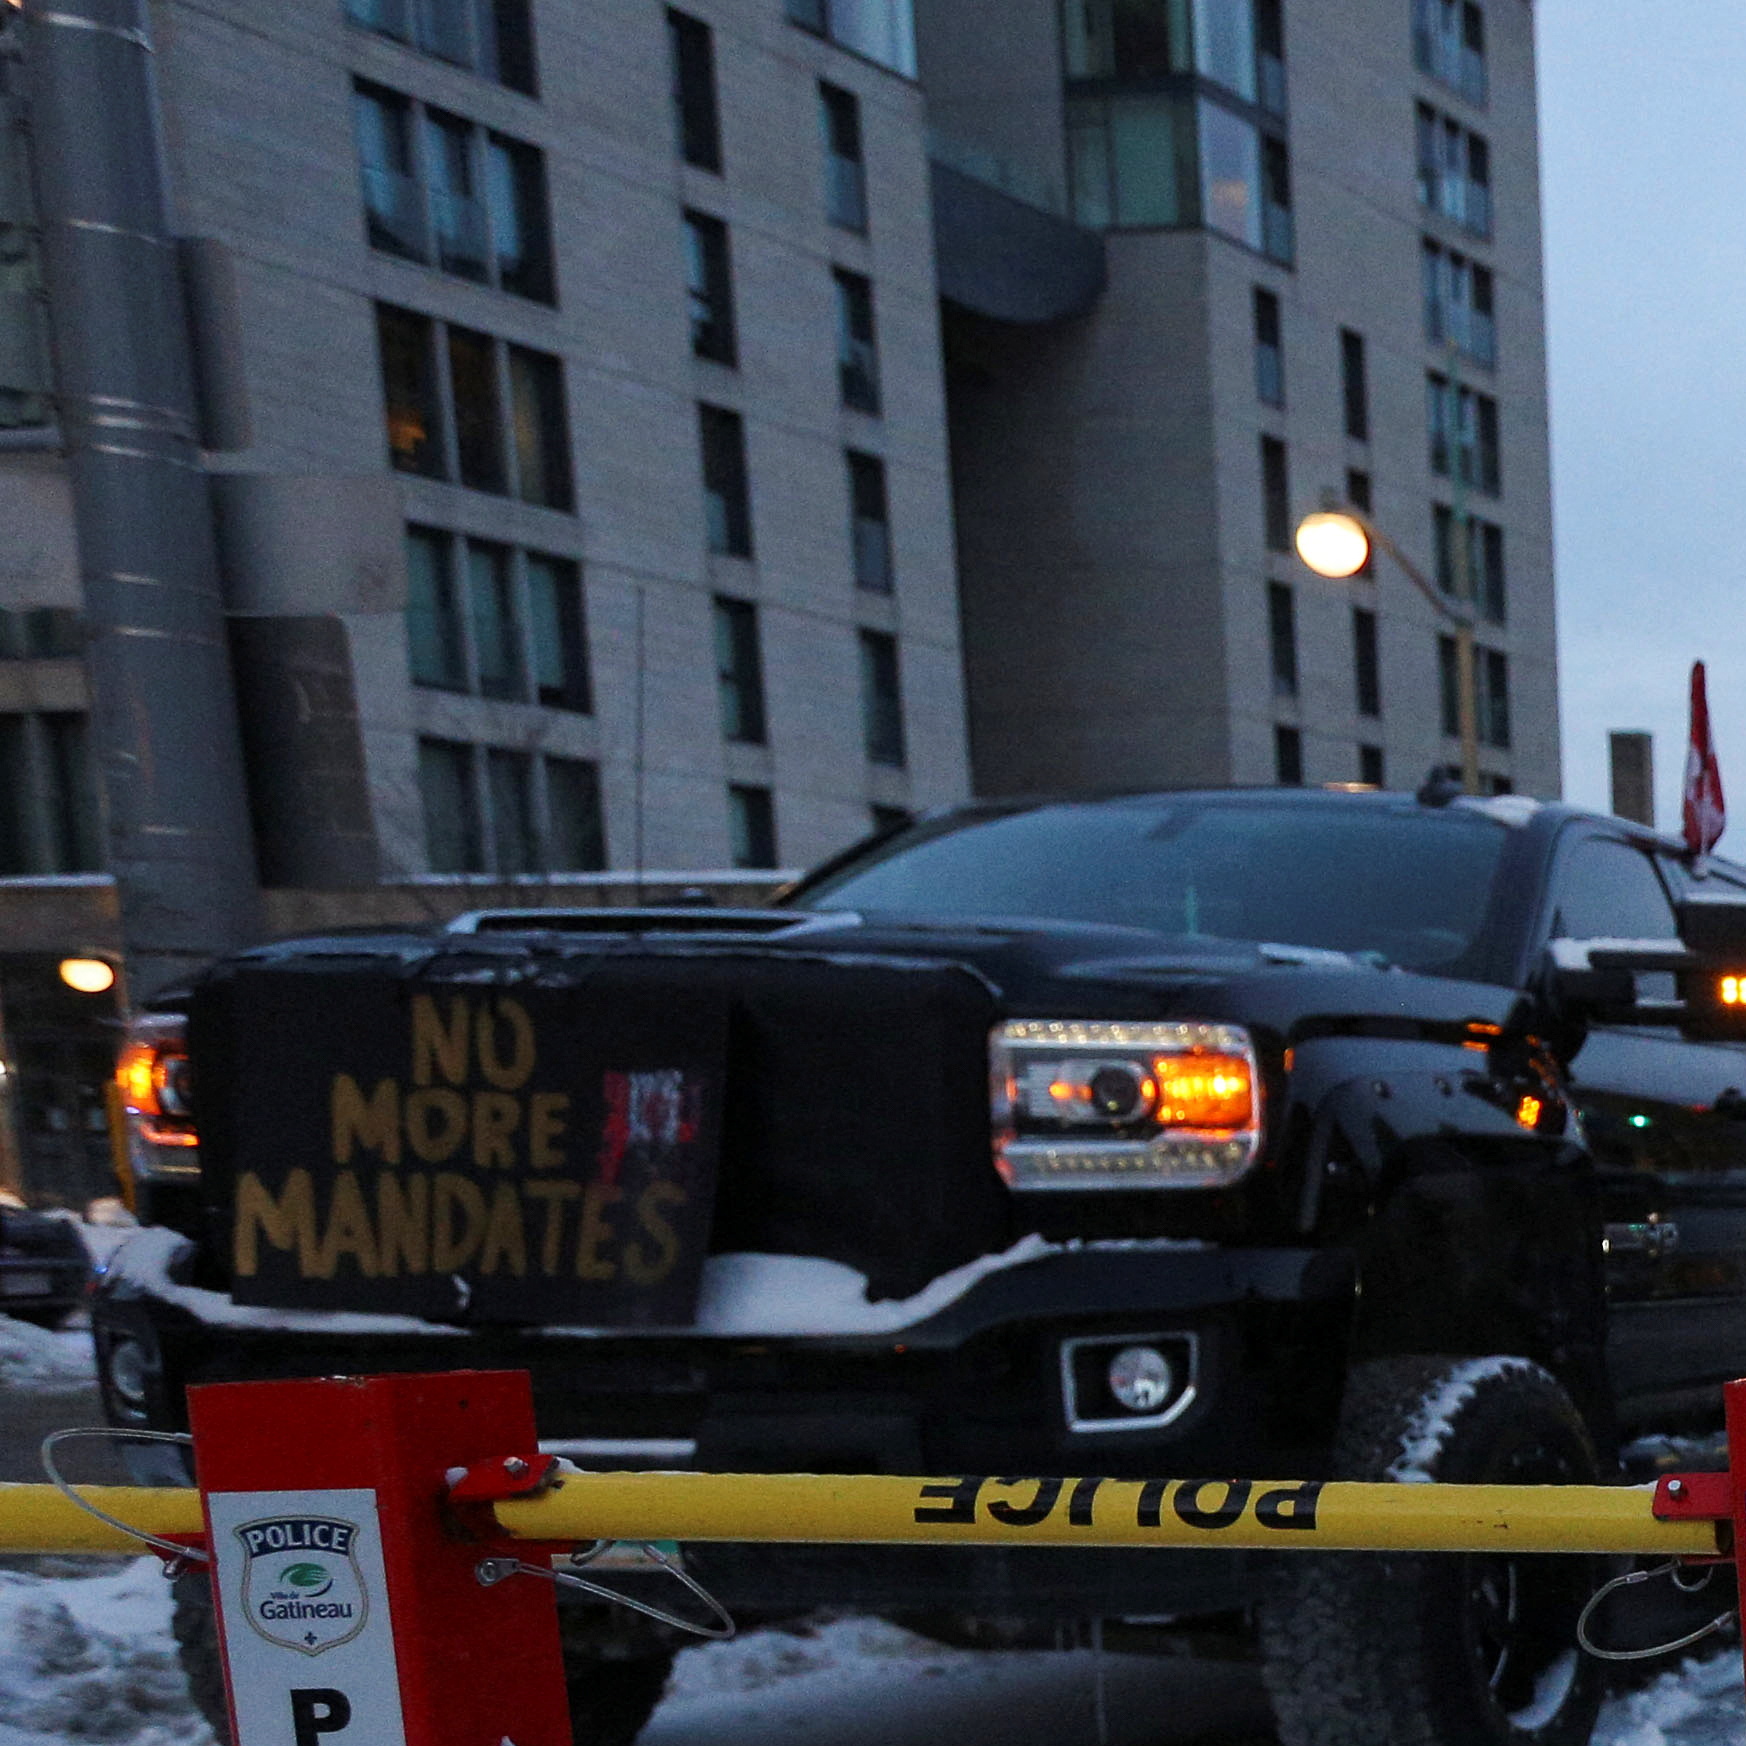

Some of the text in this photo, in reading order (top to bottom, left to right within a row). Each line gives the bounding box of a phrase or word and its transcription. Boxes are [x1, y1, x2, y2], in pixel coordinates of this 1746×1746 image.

[411, 993, 537, 1089] NO
[331, 1073, 570, 1171] MORE
[234, 1168, 688, 1284] MANDATES
[245, 1523, 349, 1554] POLICE
[915, 1475, 1325, 1531] POLICE
[259, 1601, 353, 1620] Gatineau
